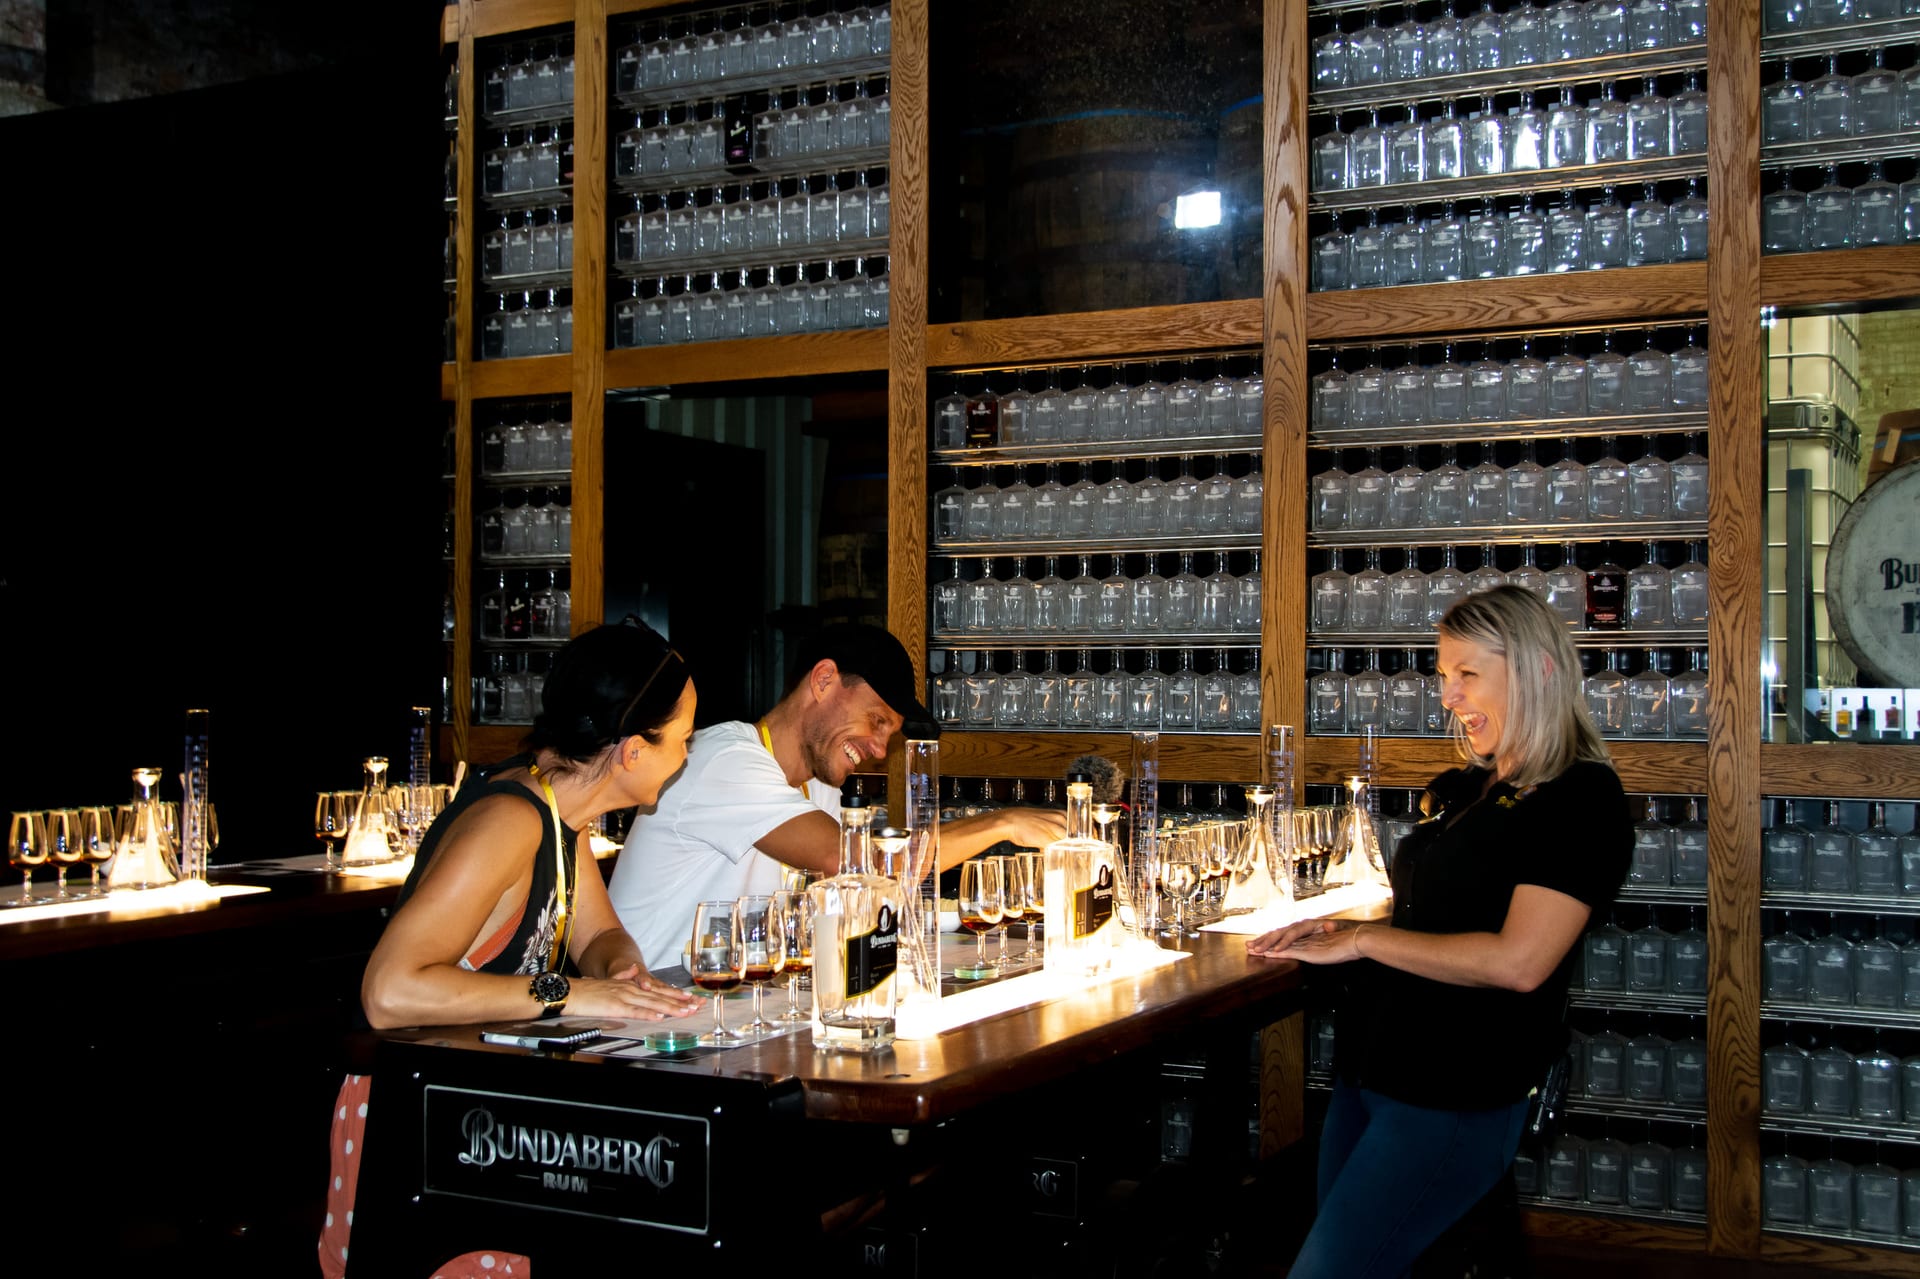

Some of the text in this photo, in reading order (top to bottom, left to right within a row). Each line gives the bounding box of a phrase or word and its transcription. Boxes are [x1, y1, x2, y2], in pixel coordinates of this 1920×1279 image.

[1880, 558, 1920, 591] BU
[458, 1105, 675, 1193] BUNDABERG
[543, 1171, 589, 1194] RUM
